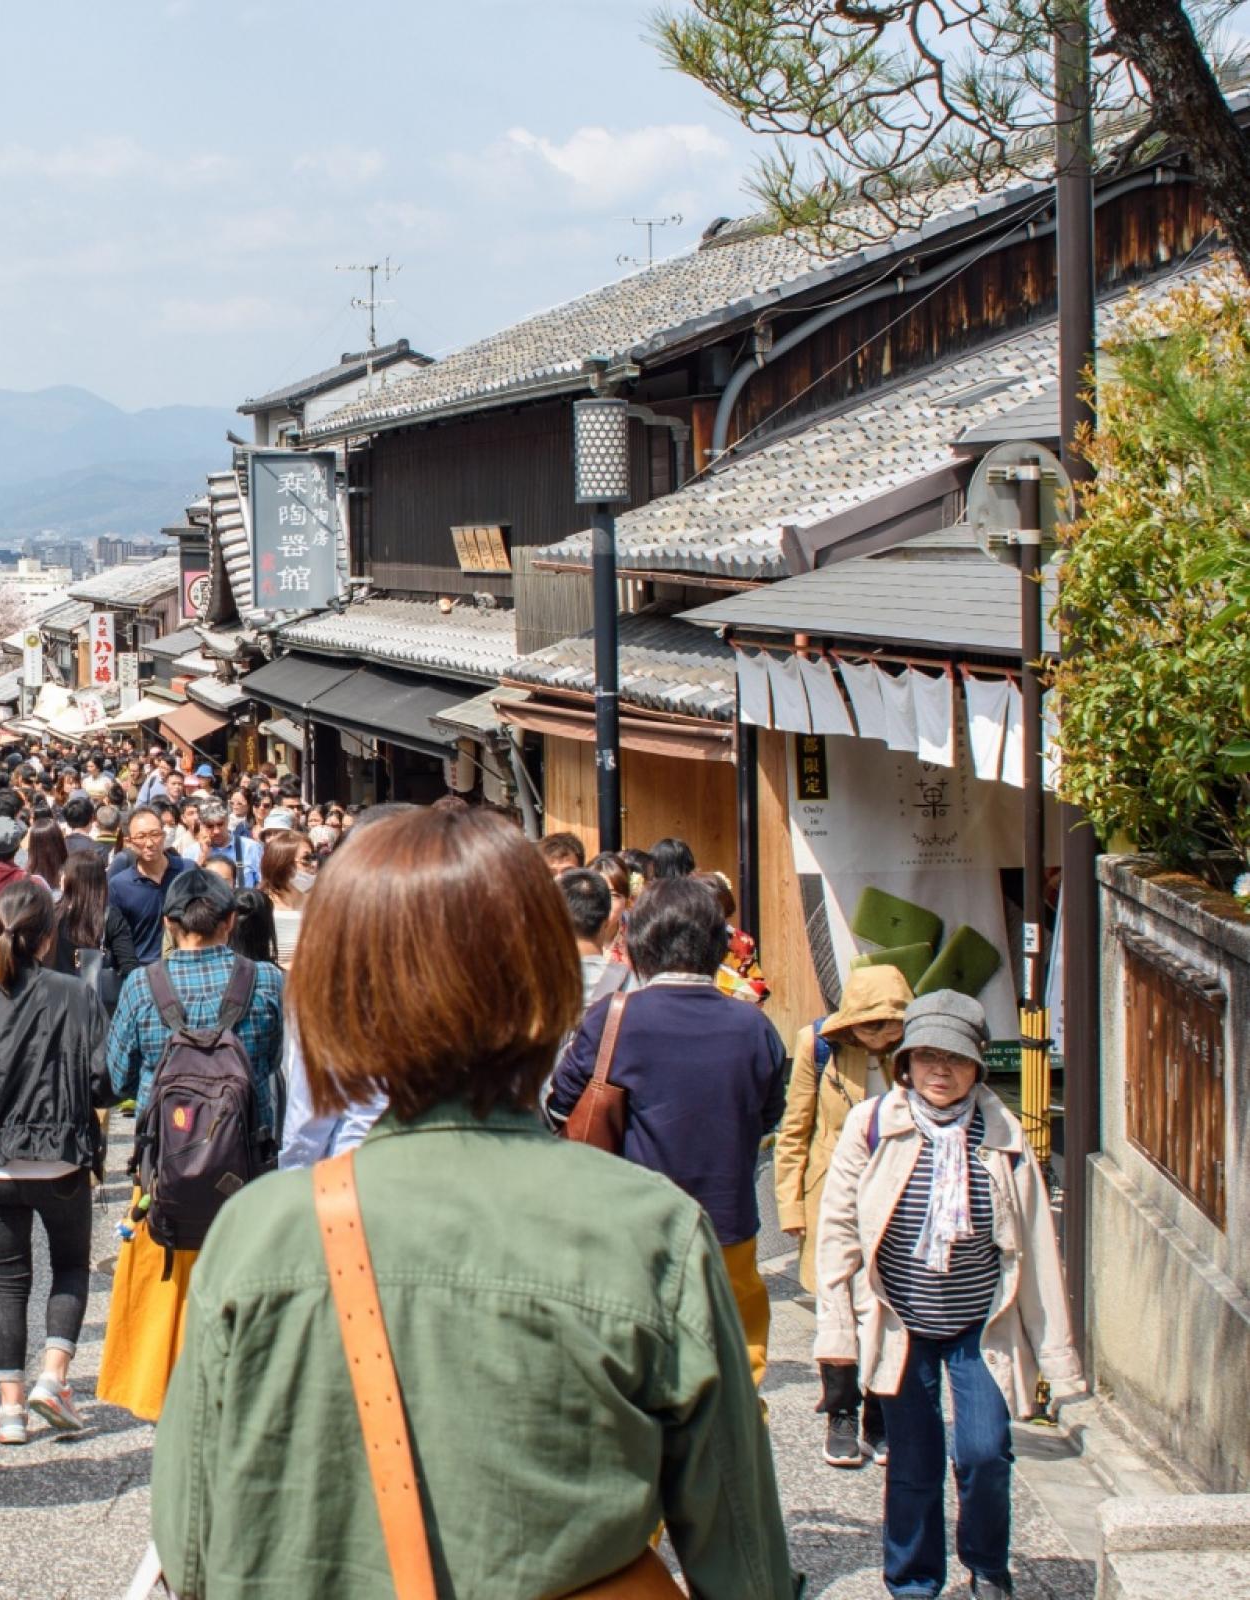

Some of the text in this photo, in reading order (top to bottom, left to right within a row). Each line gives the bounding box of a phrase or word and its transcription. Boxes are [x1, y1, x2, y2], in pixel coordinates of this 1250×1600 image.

[276, 472, 312, 591] 森陶器館
[803, 805, 825, 816] Only
[810, 817, 819, 825] in
[803, 828, 828, 838] Kyoto
